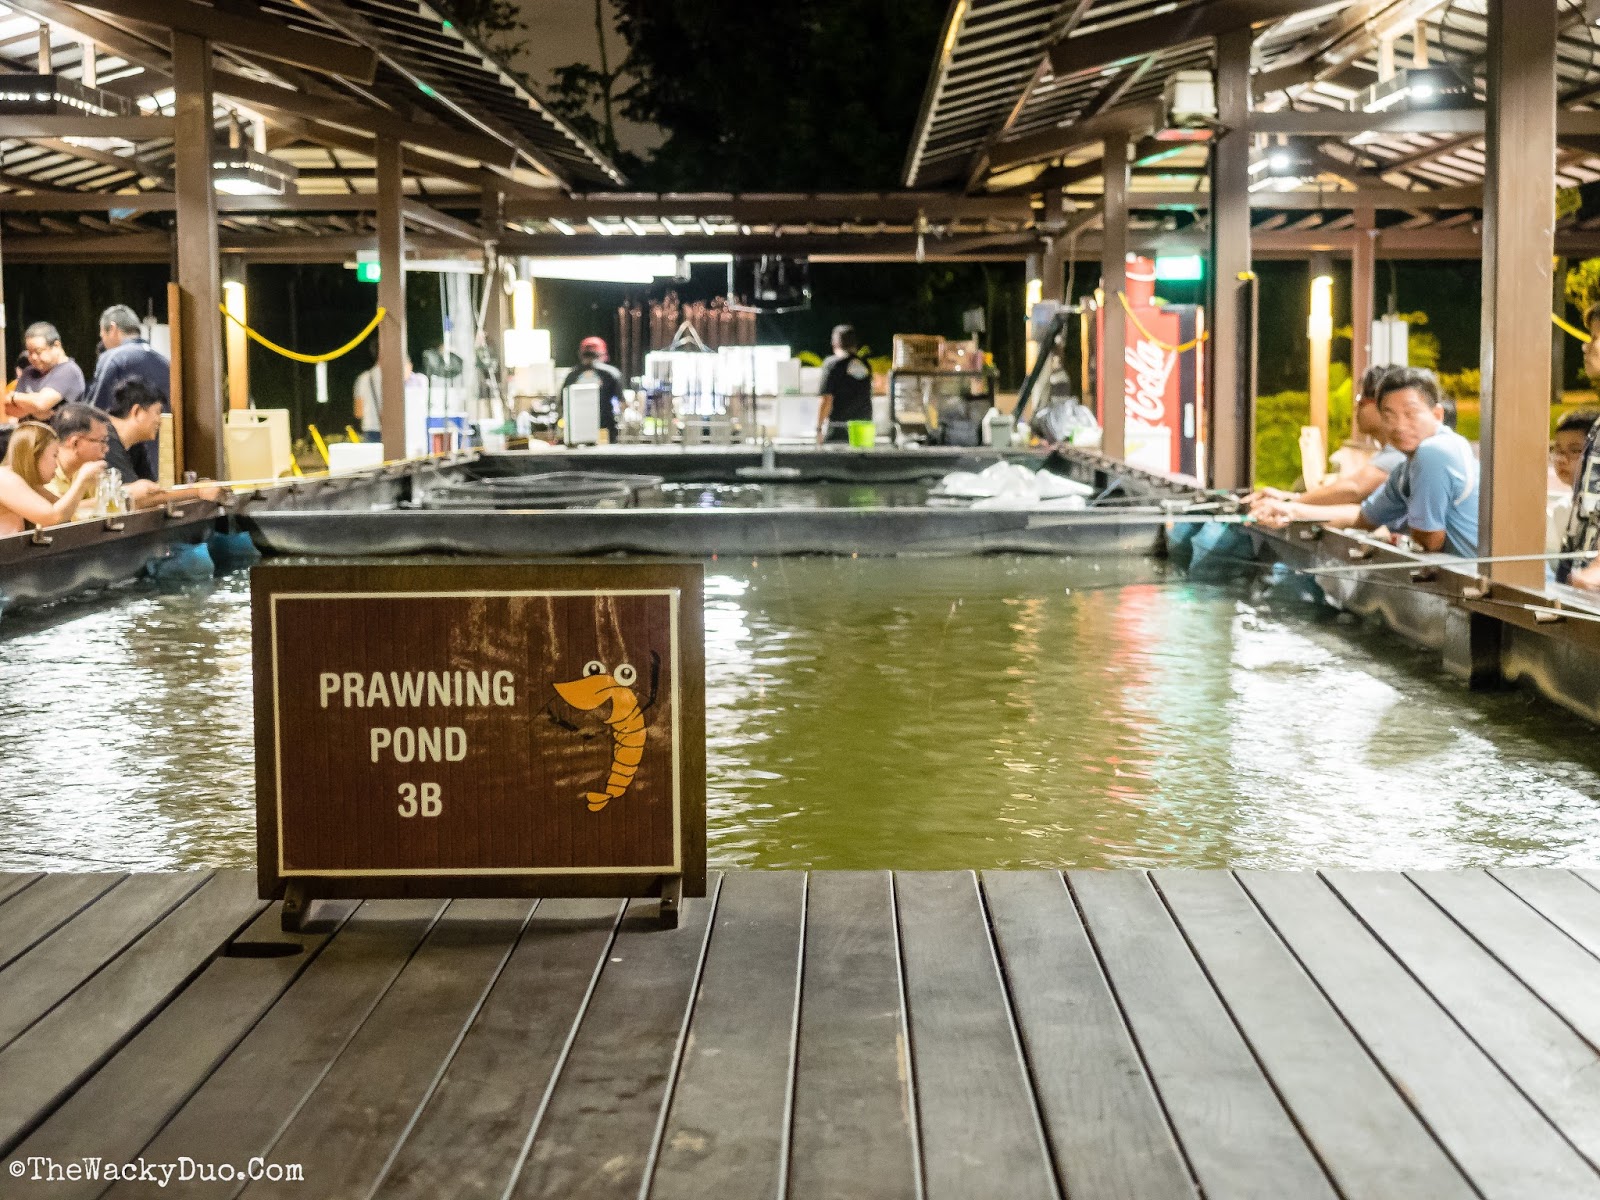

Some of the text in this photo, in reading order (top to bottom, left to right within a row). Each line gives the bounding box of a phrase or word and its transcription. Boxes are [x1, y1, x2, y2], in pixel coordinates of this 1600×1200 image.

[319, 670, 516, 708] PRAWNING
[370, 726, 468, 763] POND
[397, 782, 443, 818] 3B
